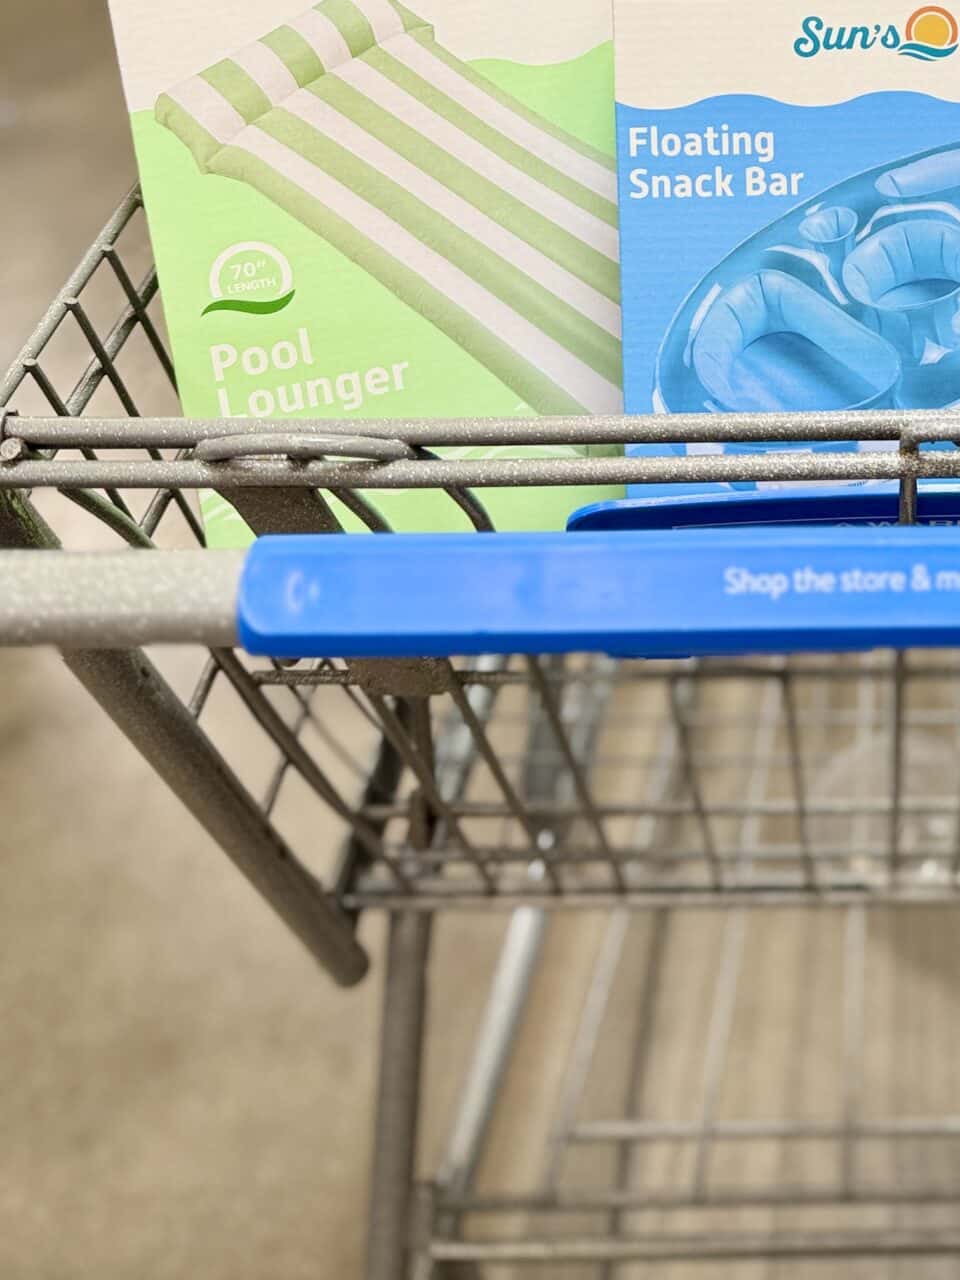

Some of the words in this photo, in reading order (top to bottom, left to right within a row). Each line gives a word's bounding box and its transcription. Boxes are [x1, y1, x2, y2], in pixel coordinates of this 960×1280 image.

[793, 15, 900, 58] Sun's
[629, 124, 775, 162] Floating
[629, 166, 735, 200] Snack
[745, 166, 805, 197] Bar
[227, 276, 277, 294] LENGTH
[209, 327, 314, 381] Pool
[216, 360, 409, 418] Lounger
[724, 566, 789, 600] Shop
[793, 565, 836, 593] the
[841, 567, 906, 593] store
[911, 563, 932, 592] &
